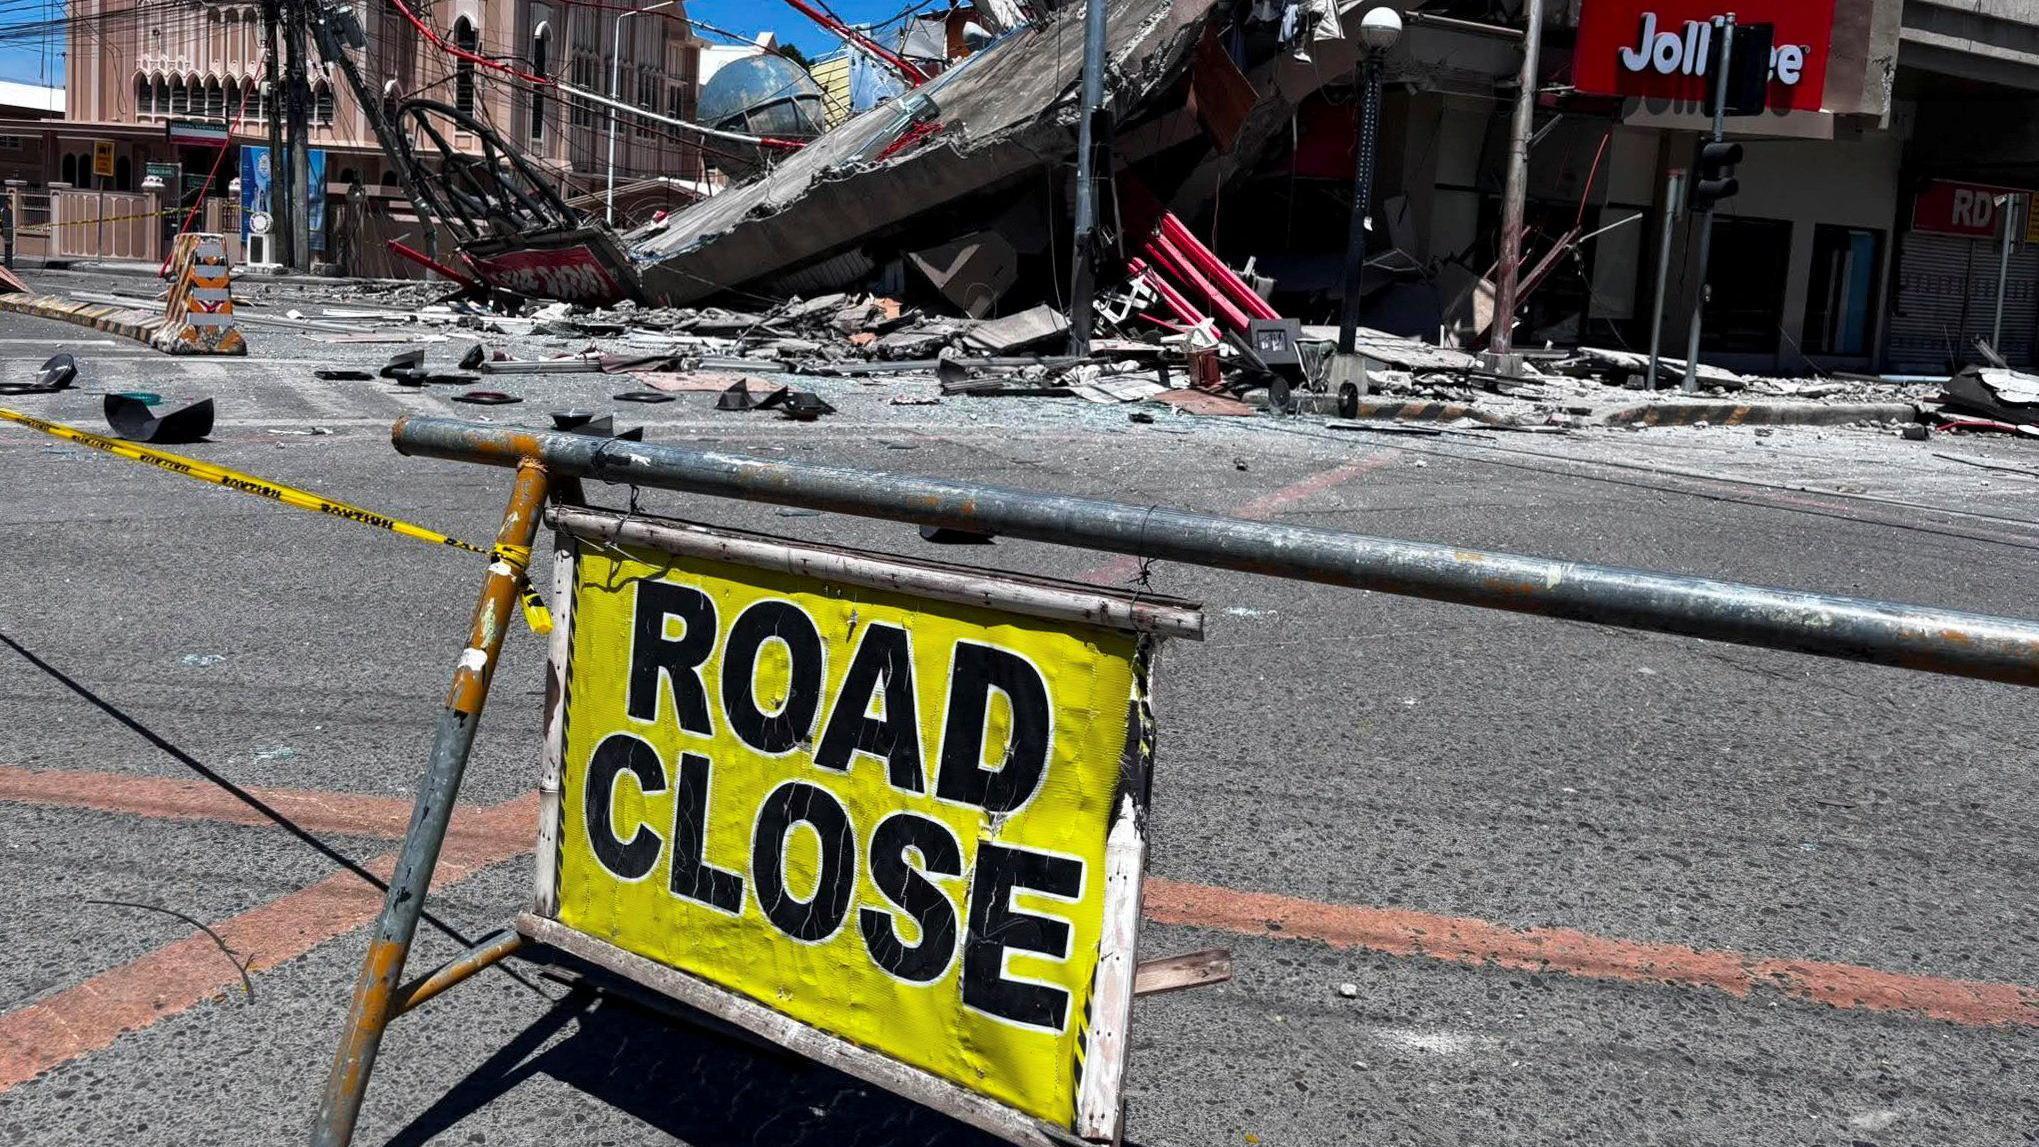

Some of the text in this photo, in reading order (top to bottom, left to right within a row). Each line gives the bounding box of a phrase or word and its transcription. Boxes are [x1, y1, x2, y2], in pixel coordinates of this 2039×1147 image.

[1618, 12, 1804, 86] Jolle
[628, 579, 1053, 814] ROAD
[585, 732, 1083, 1031] CLOSE
